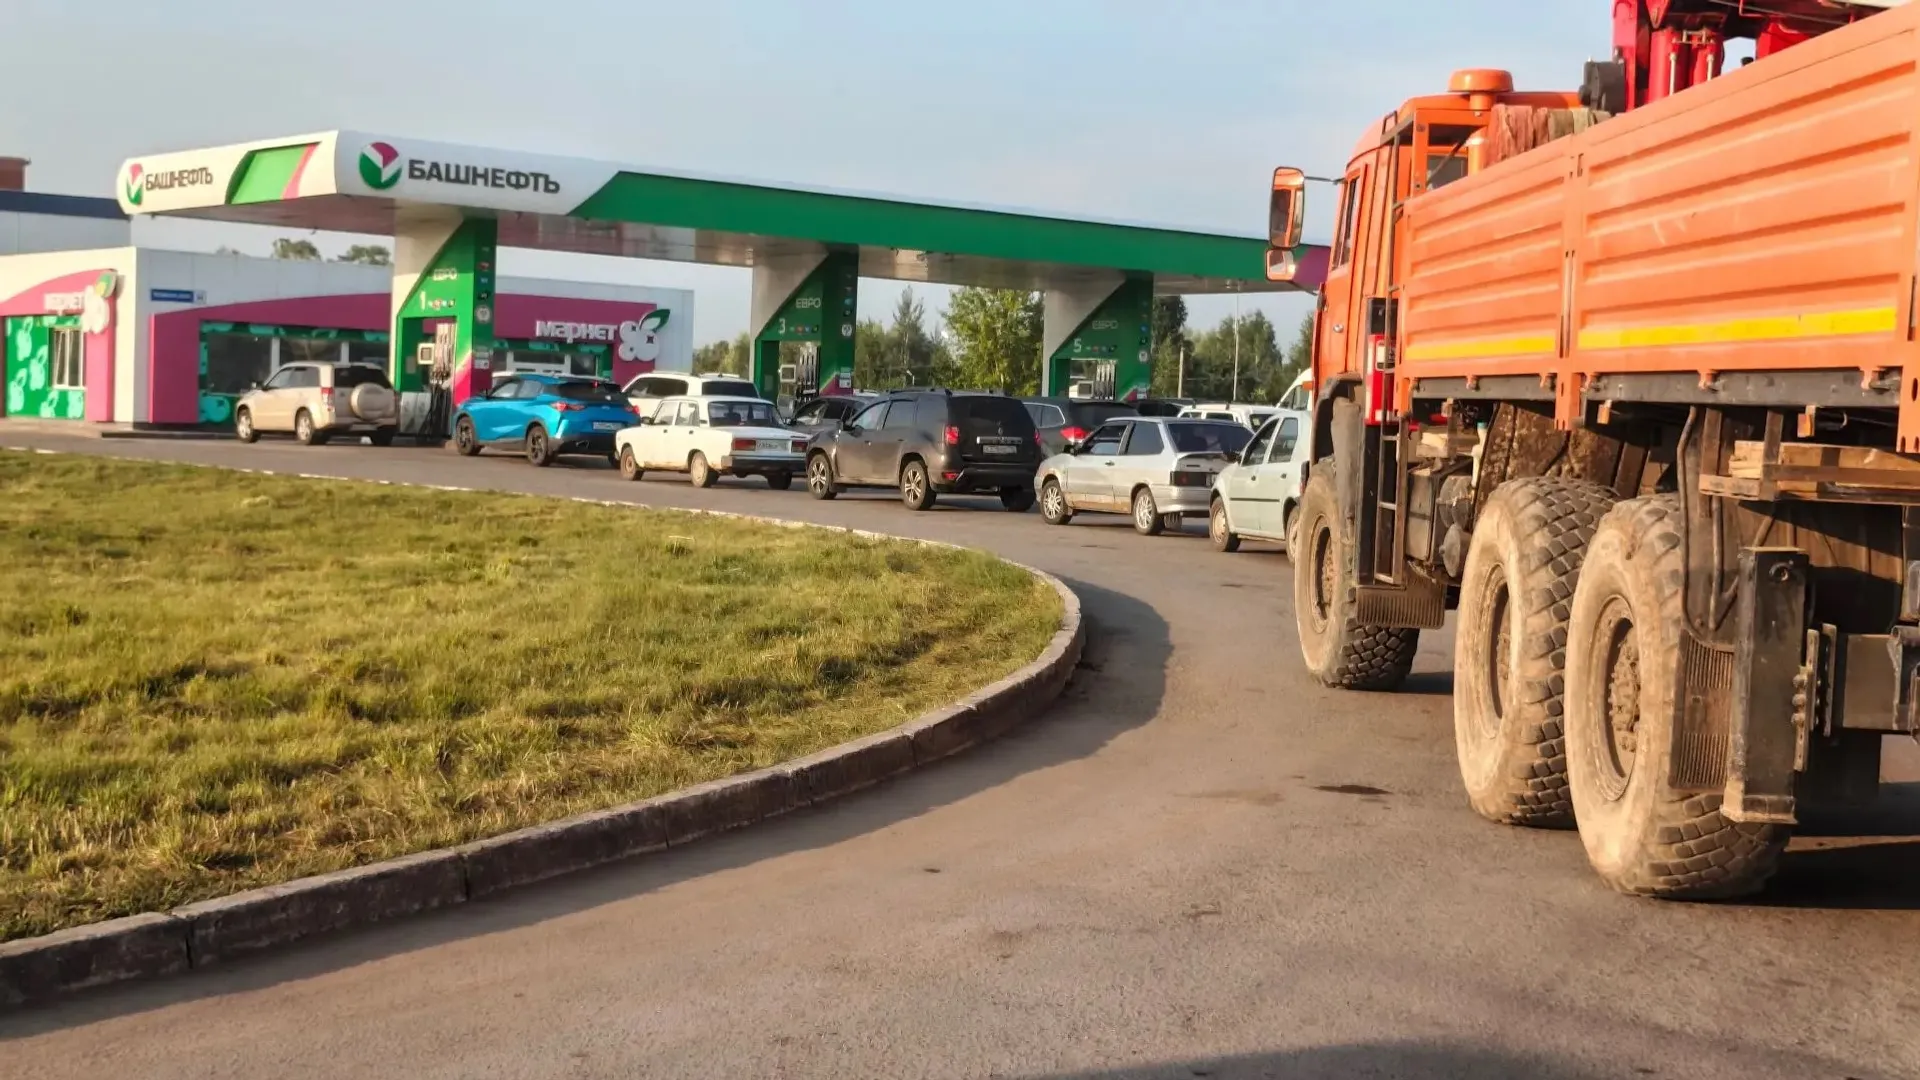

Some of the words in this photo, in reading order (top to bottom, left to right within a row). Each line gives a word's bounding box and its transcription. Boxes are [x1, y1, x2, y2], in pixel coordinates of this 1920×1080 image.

[145, 166, 214, 191] БАШНЕФТЬ
[408, 158, 561, 194] БАШНЕФТЬ
[778, 317, 786, 334] 3
[1073, 337, 1082, 353] 5
